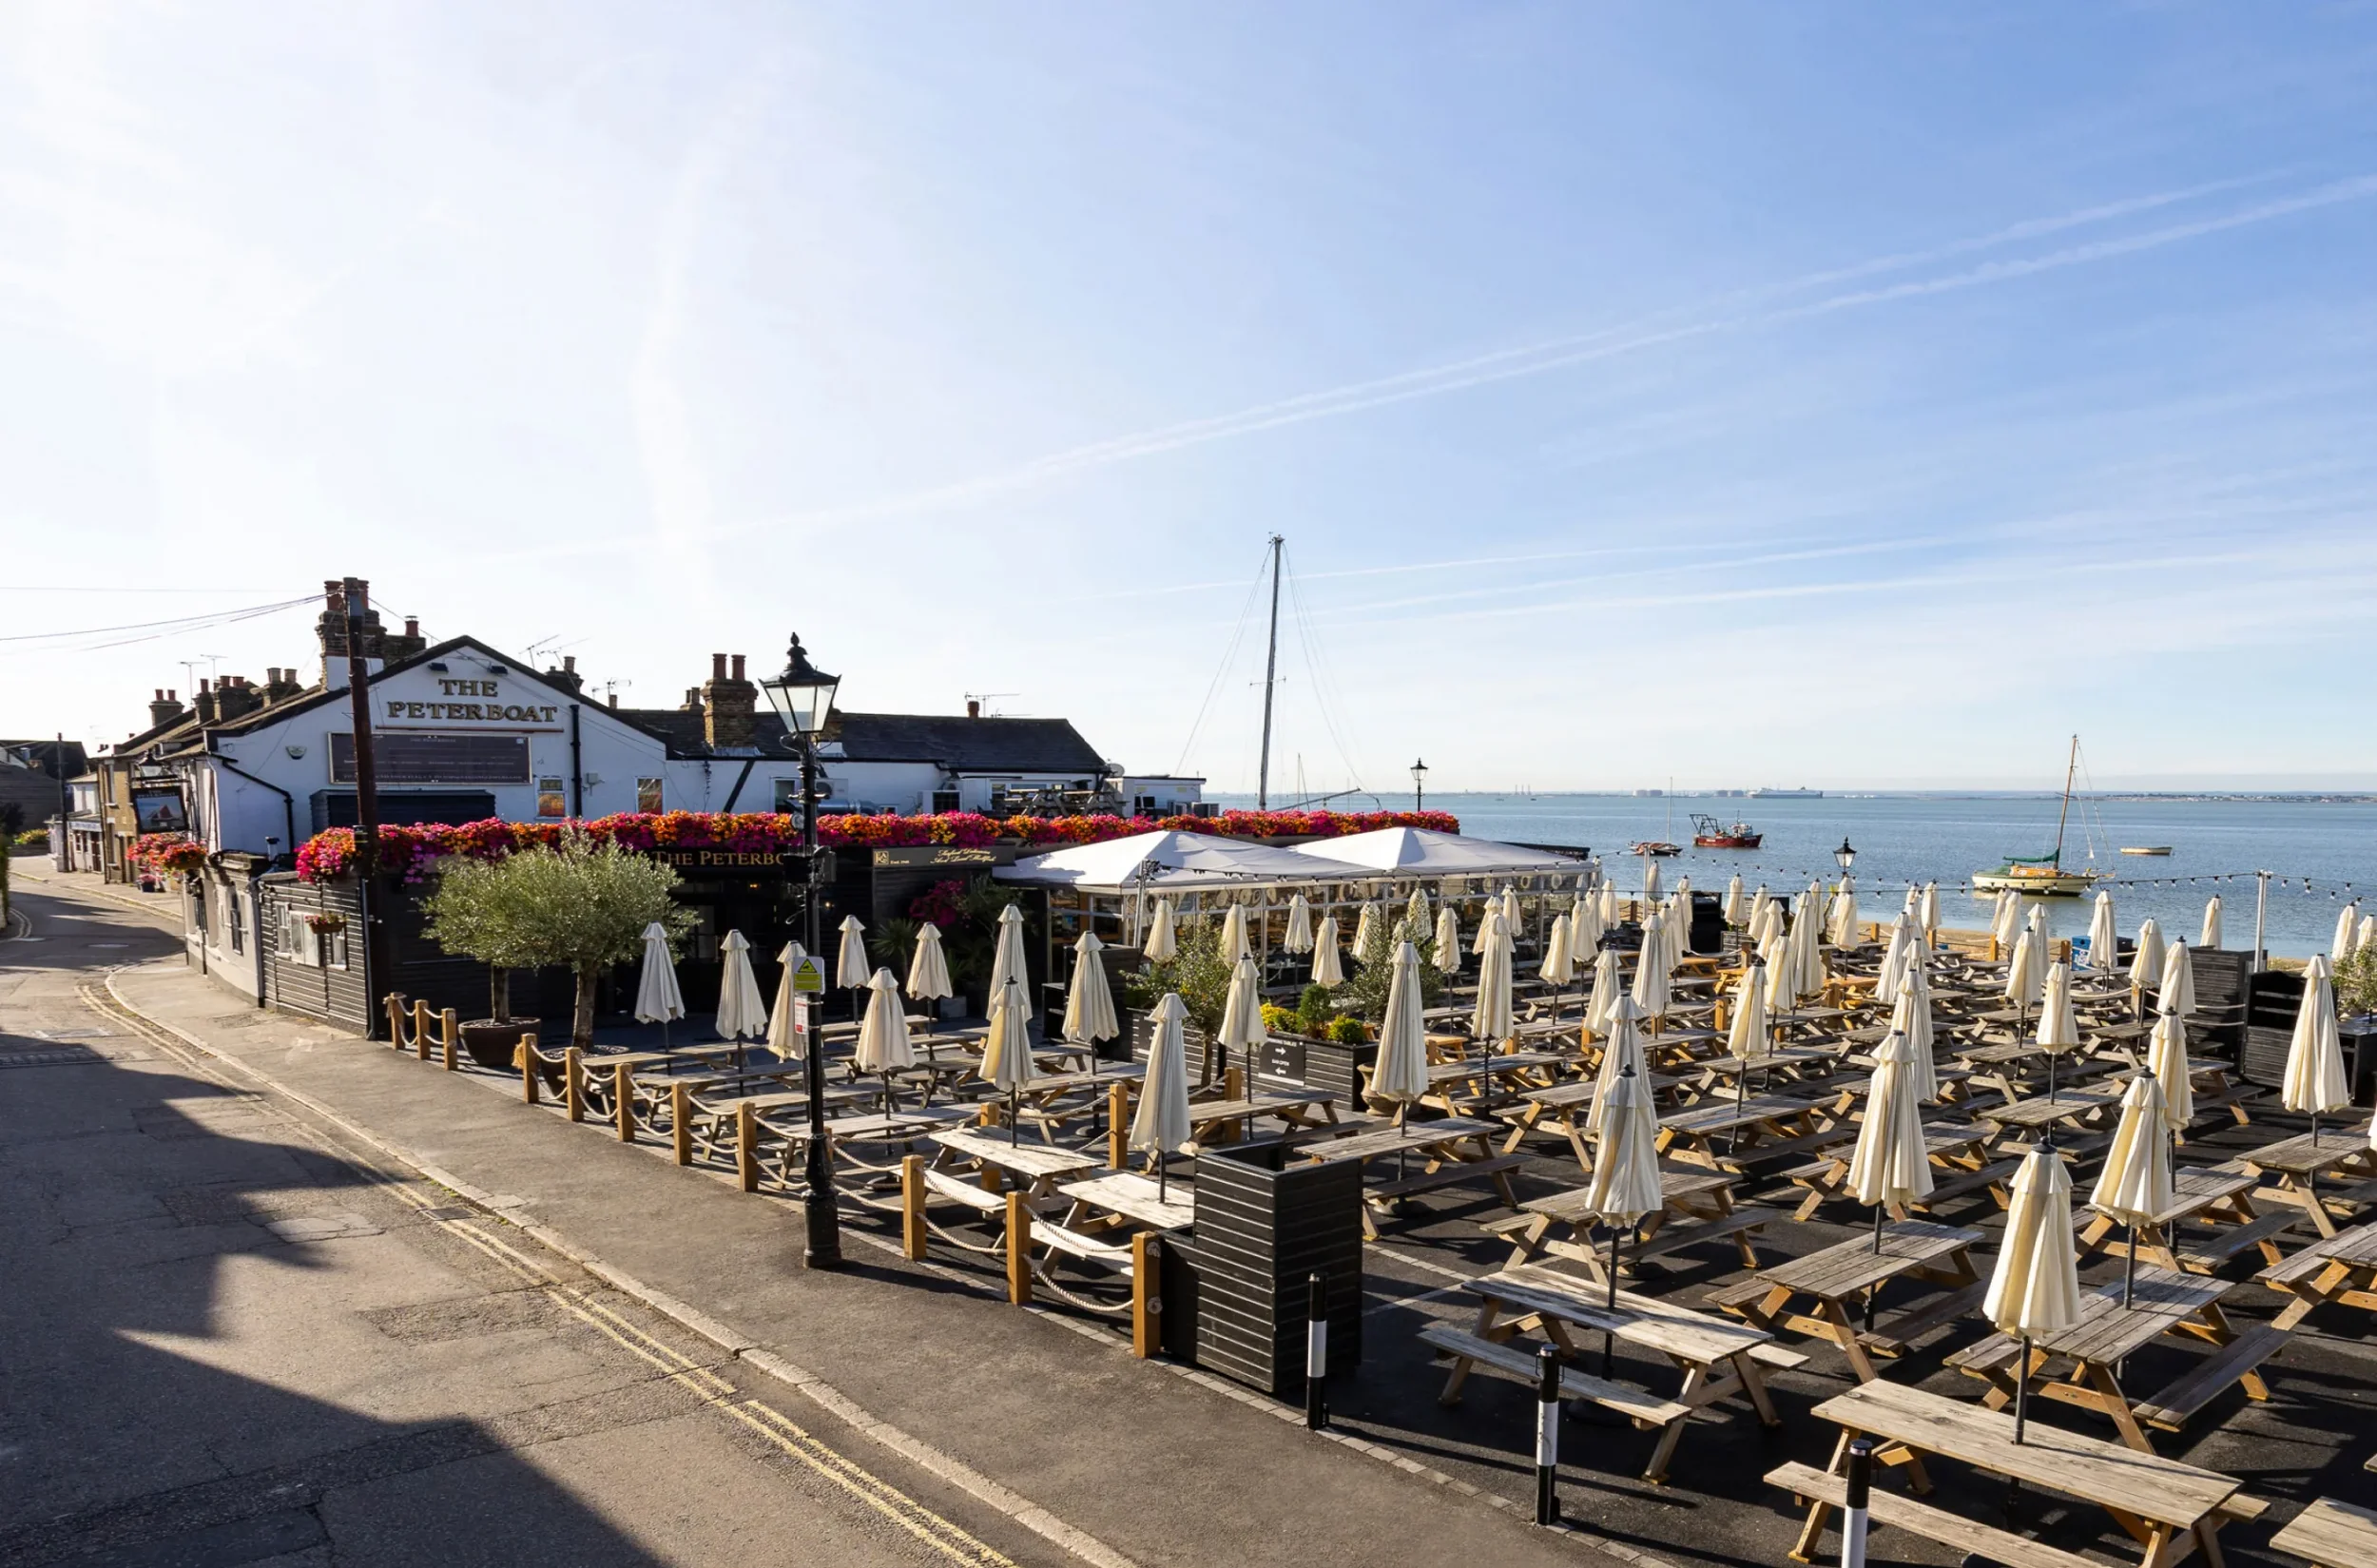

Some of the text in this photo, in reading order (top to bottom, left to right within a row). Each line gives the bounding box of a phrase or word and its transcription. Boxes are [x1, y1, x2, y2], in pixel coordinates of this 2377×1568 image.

[438, 679, 498, 697] THE
[387, 701, 558, 723] PETERBOAT
[651, 850, 784, 865] THE PETERBO
